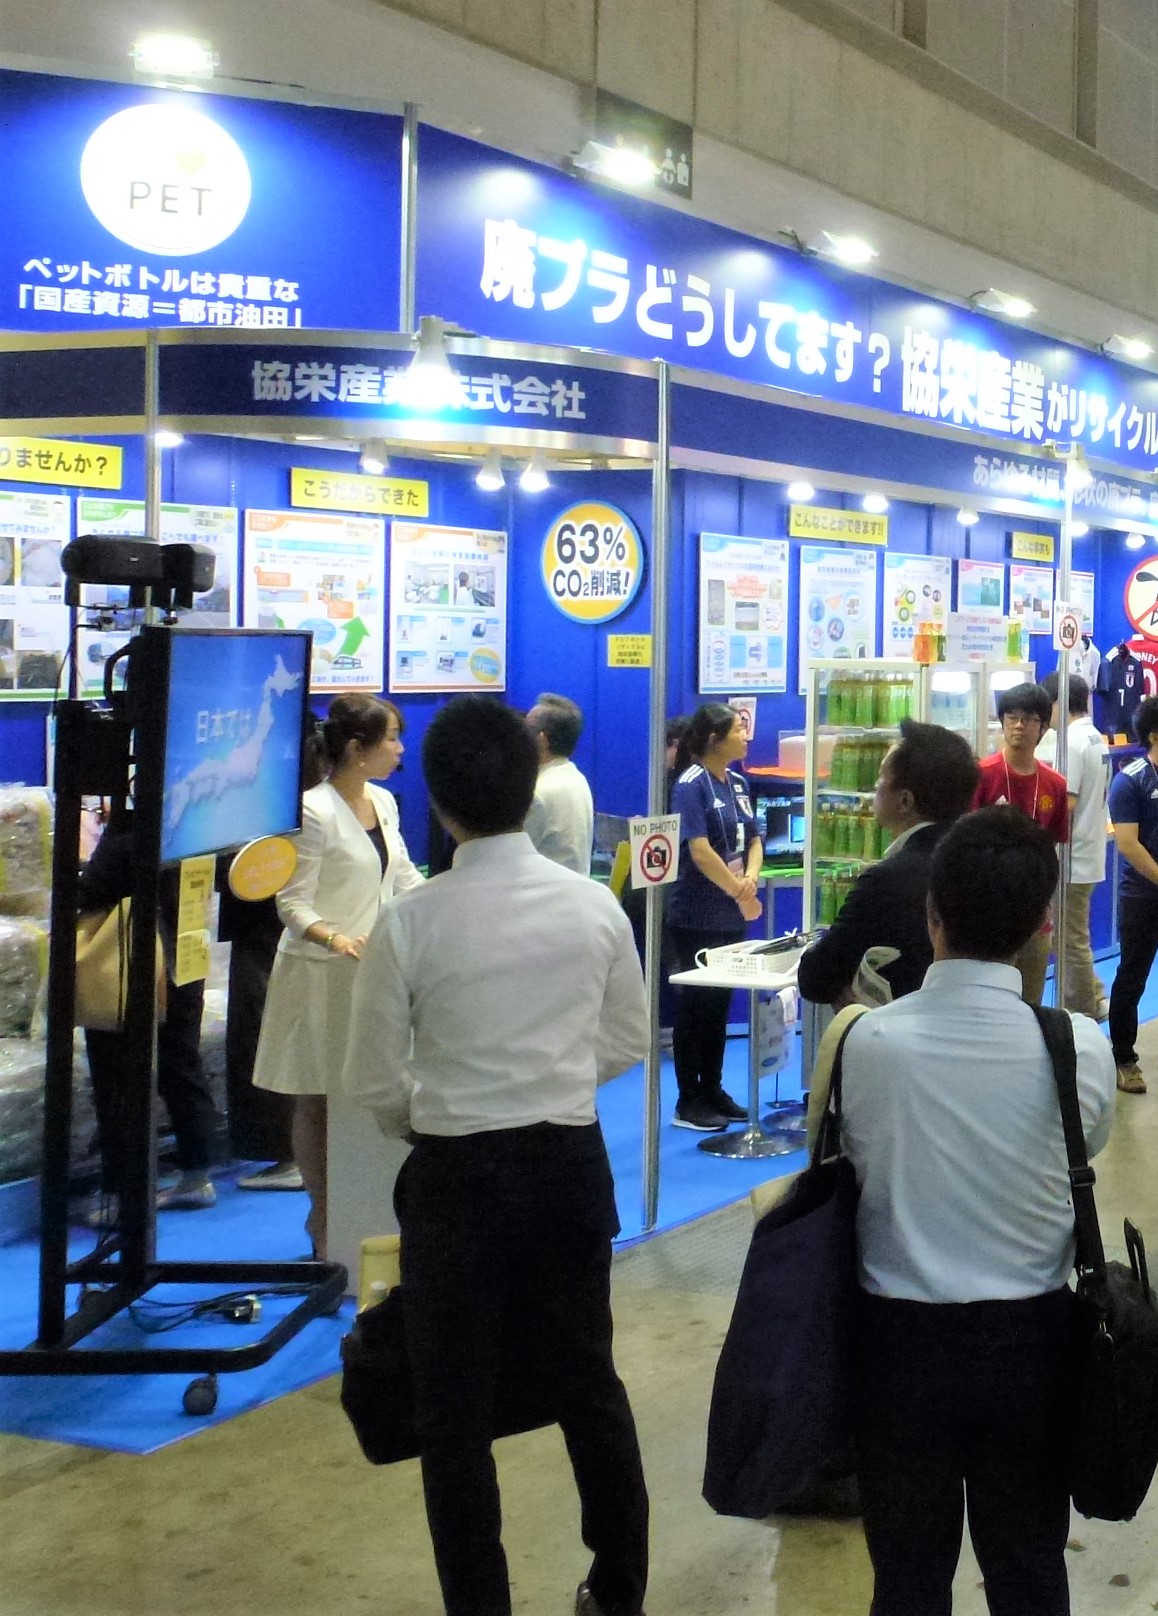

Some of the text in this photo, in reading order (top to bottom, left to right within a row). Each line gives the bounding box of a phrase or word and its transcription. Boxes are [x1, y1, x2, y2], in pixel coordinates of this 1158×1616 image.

[128, 180, 213, 217] PET
[23, 257, 300, 303] ペットボトルは貴重な
[252, 359, 586, 420] 協栄産式会社
[556, 522, 626, 565] 63%
[633, 819, 677, 836] NO PHOTO
